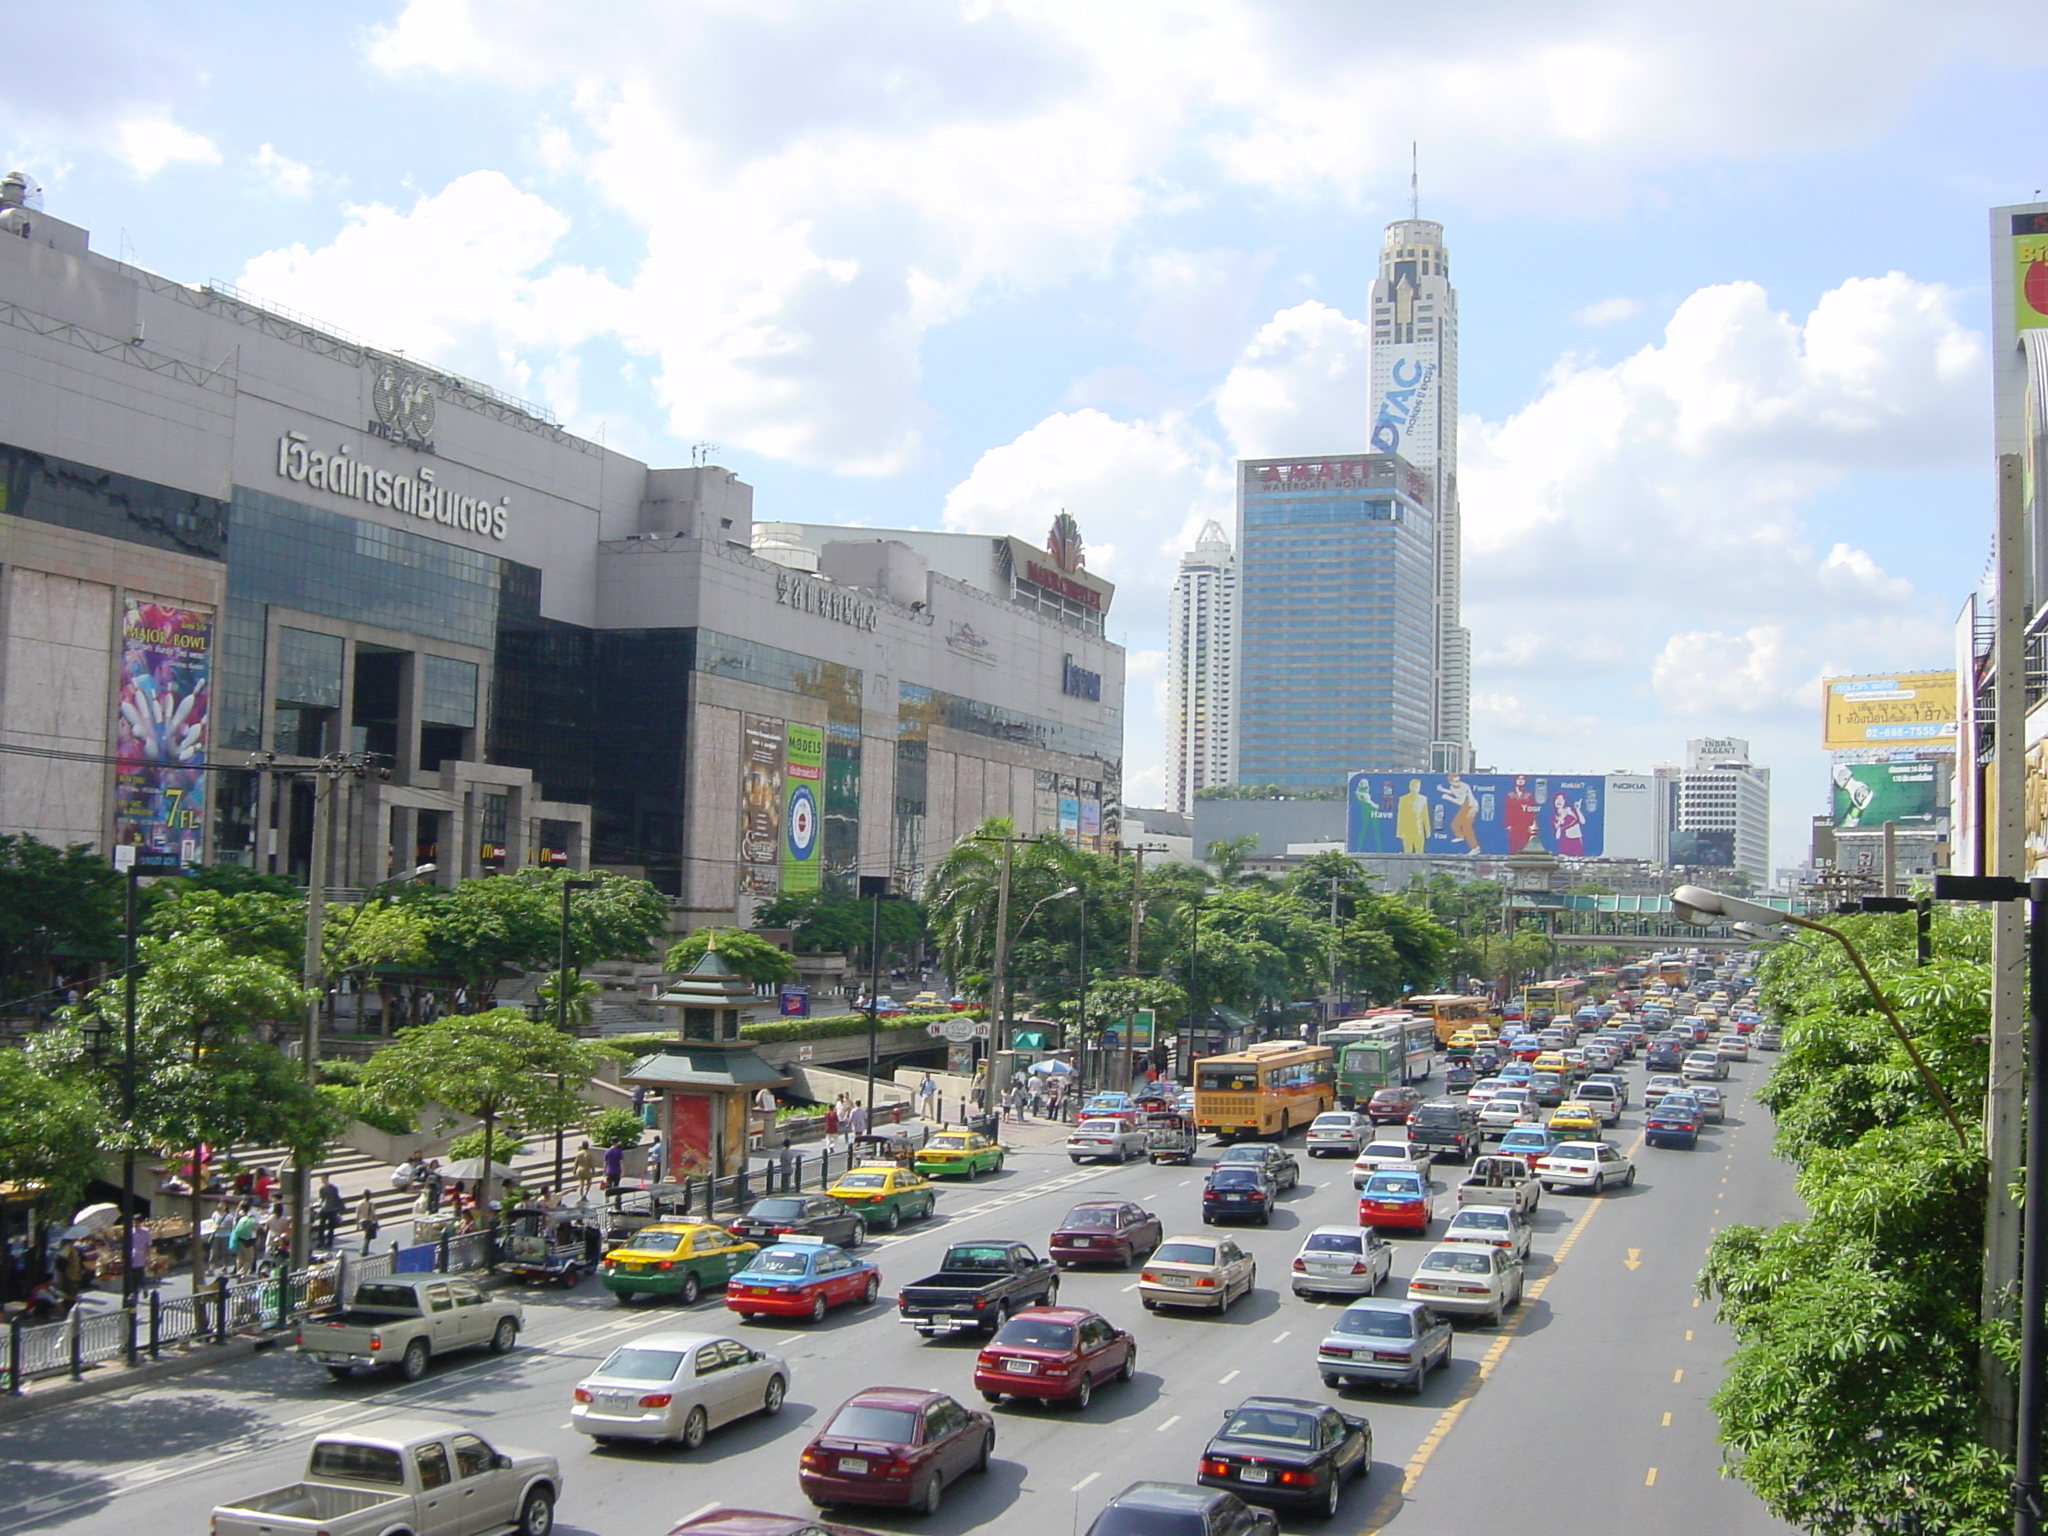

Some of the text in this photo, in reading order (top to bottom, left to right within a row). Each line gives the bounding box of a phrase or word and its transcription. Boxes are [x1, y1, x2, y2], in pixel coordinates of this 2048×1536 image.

[1370, 358, 1422, 454] DTAC
[1264, 460, 1371, 482] AMARI
[278, 431, 511, 541] เวิลด์เทรดเซ็นเตอร์
[1262, 480, 1369, 492] WATERGATE HOTEL
[126, 626, 168, 645] MAJOR
[173, 633, 206, 650] BOWL
[1701, 747, 1737, 755] REGENT
[1612, 782, 1647, 790] NOKIA
[166, 789, 183, 828] 7
[180, 810, 199, 829] FL
[1371, 811, 1393, 819] Have
[1521, 803, 1541, 813] Your
